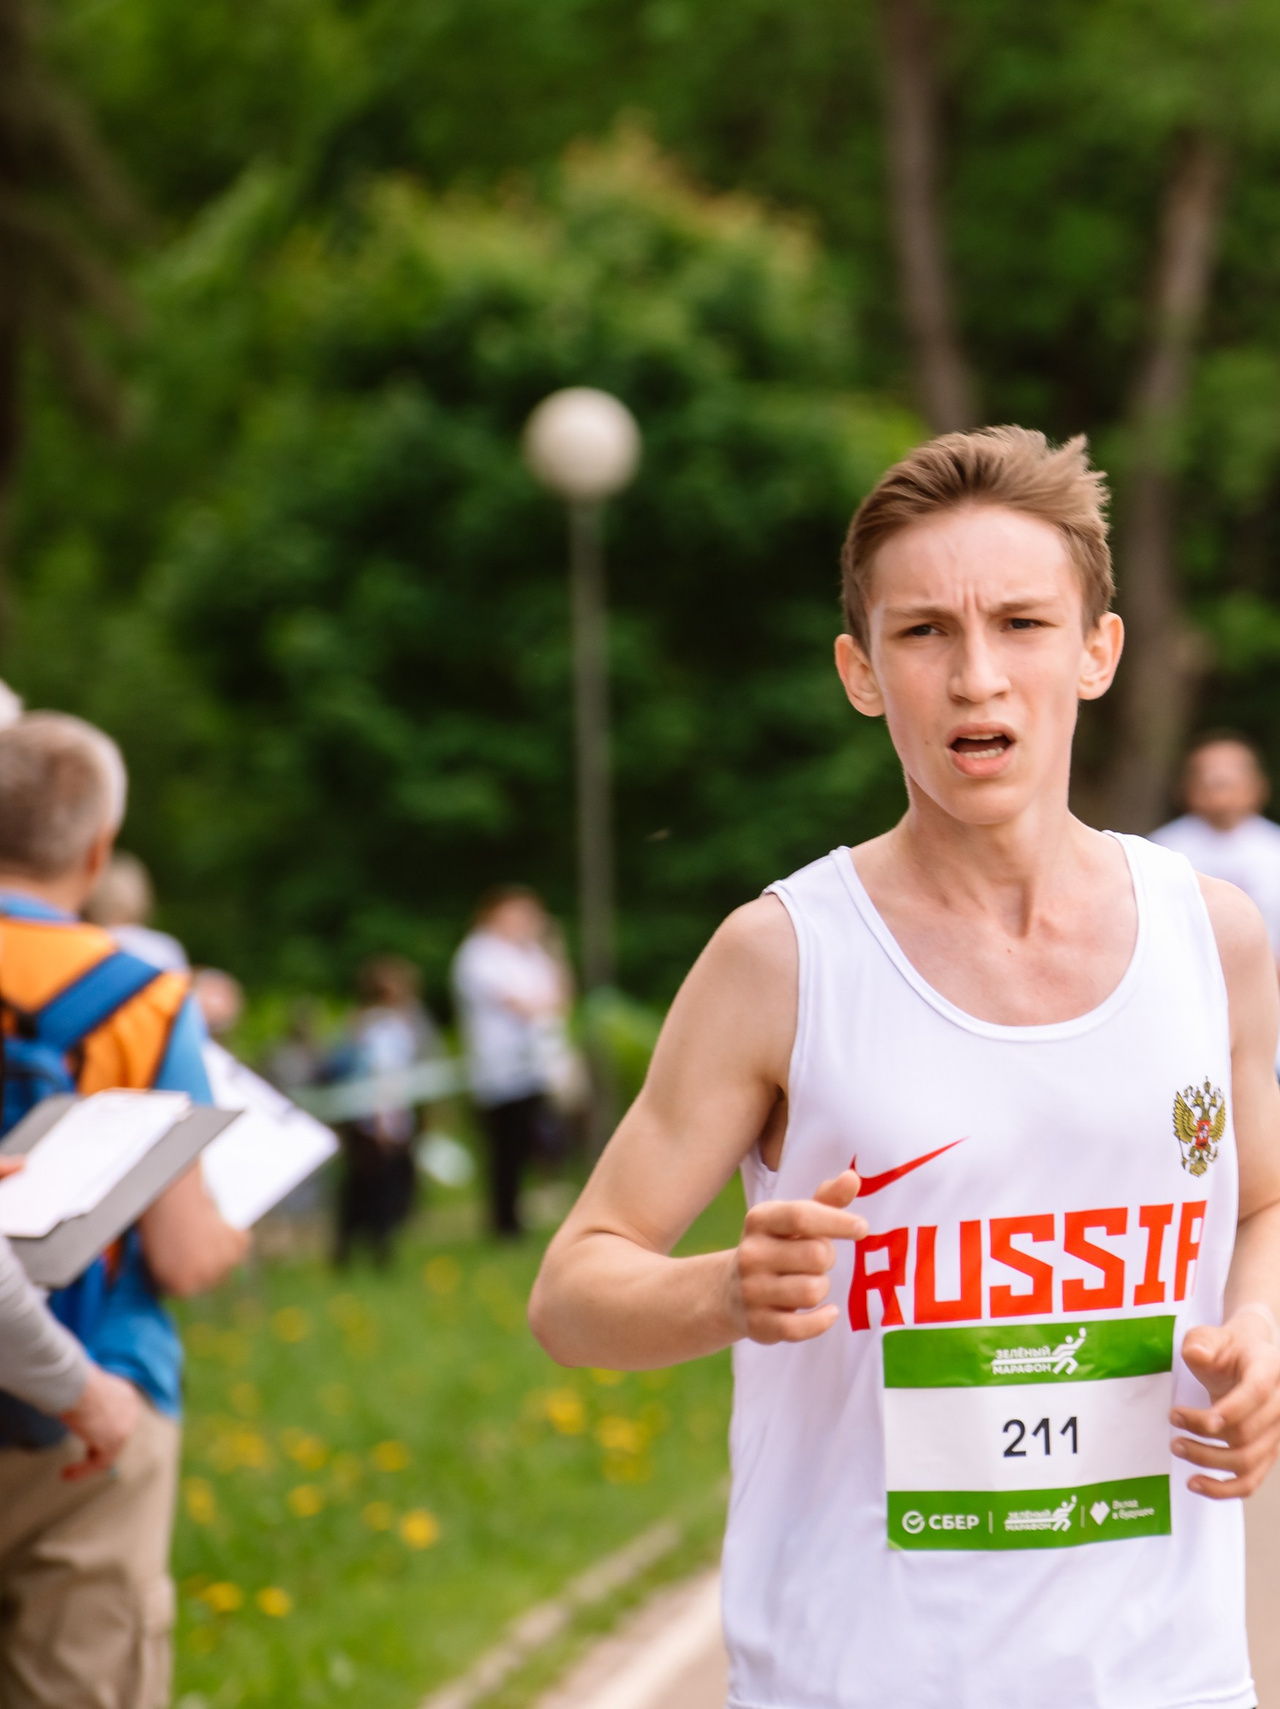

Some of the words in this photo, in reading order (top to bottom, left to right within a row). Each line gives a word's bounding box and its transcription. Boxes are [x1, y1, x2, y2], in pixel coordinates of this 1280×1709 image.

[995, 1345, 1052, 1360] ЗЕЛЁНЫЙ
[992, 1362, 1052, 1376] МАРАФОН
[1001, 1416, 1079, 1458] 211
[928, 1514, 980, 1531] СБЕР
